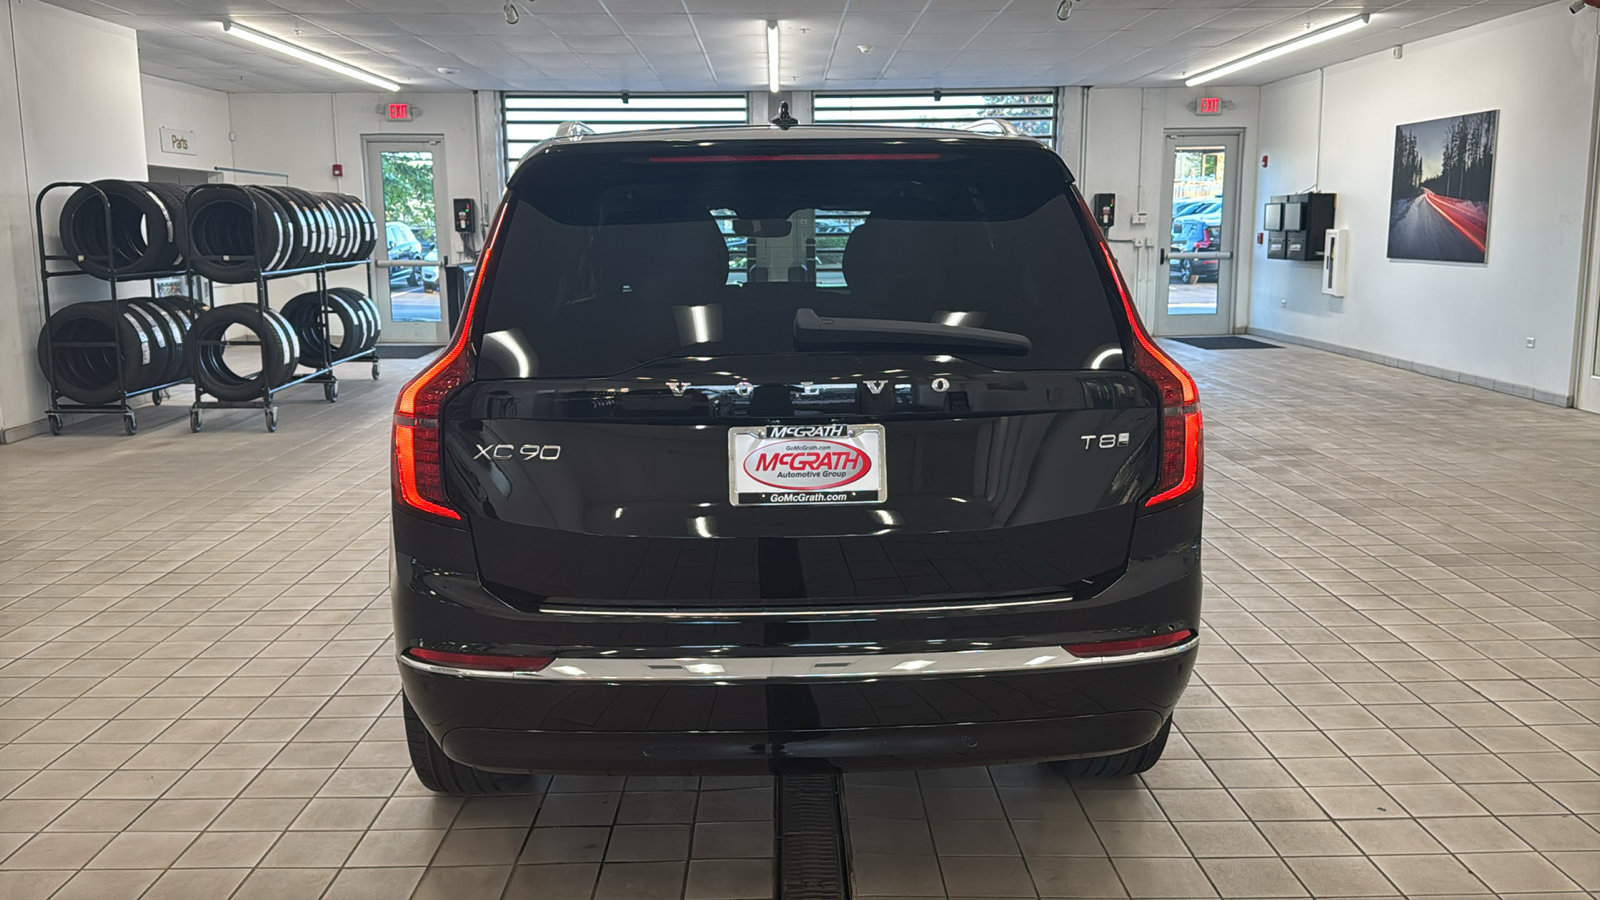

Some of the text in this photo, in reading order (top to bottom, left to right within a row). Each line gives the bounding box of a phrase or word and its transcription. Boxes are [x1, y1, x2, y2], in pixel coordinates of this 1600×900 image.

[388, 103, 408, 119] EXIT
[1200, 97, 1220, 113] EXIT
[171, 135, 189, 150] Parts
[666, 378, 950, 396] VOLVO
[770, 425, 844, 438] McGRATH
[755, 451, 860, 472] McGRATH
[776, 471, 847, 479] Automotive Group
[770, 492, 848, 502] GoMcGrath.com
